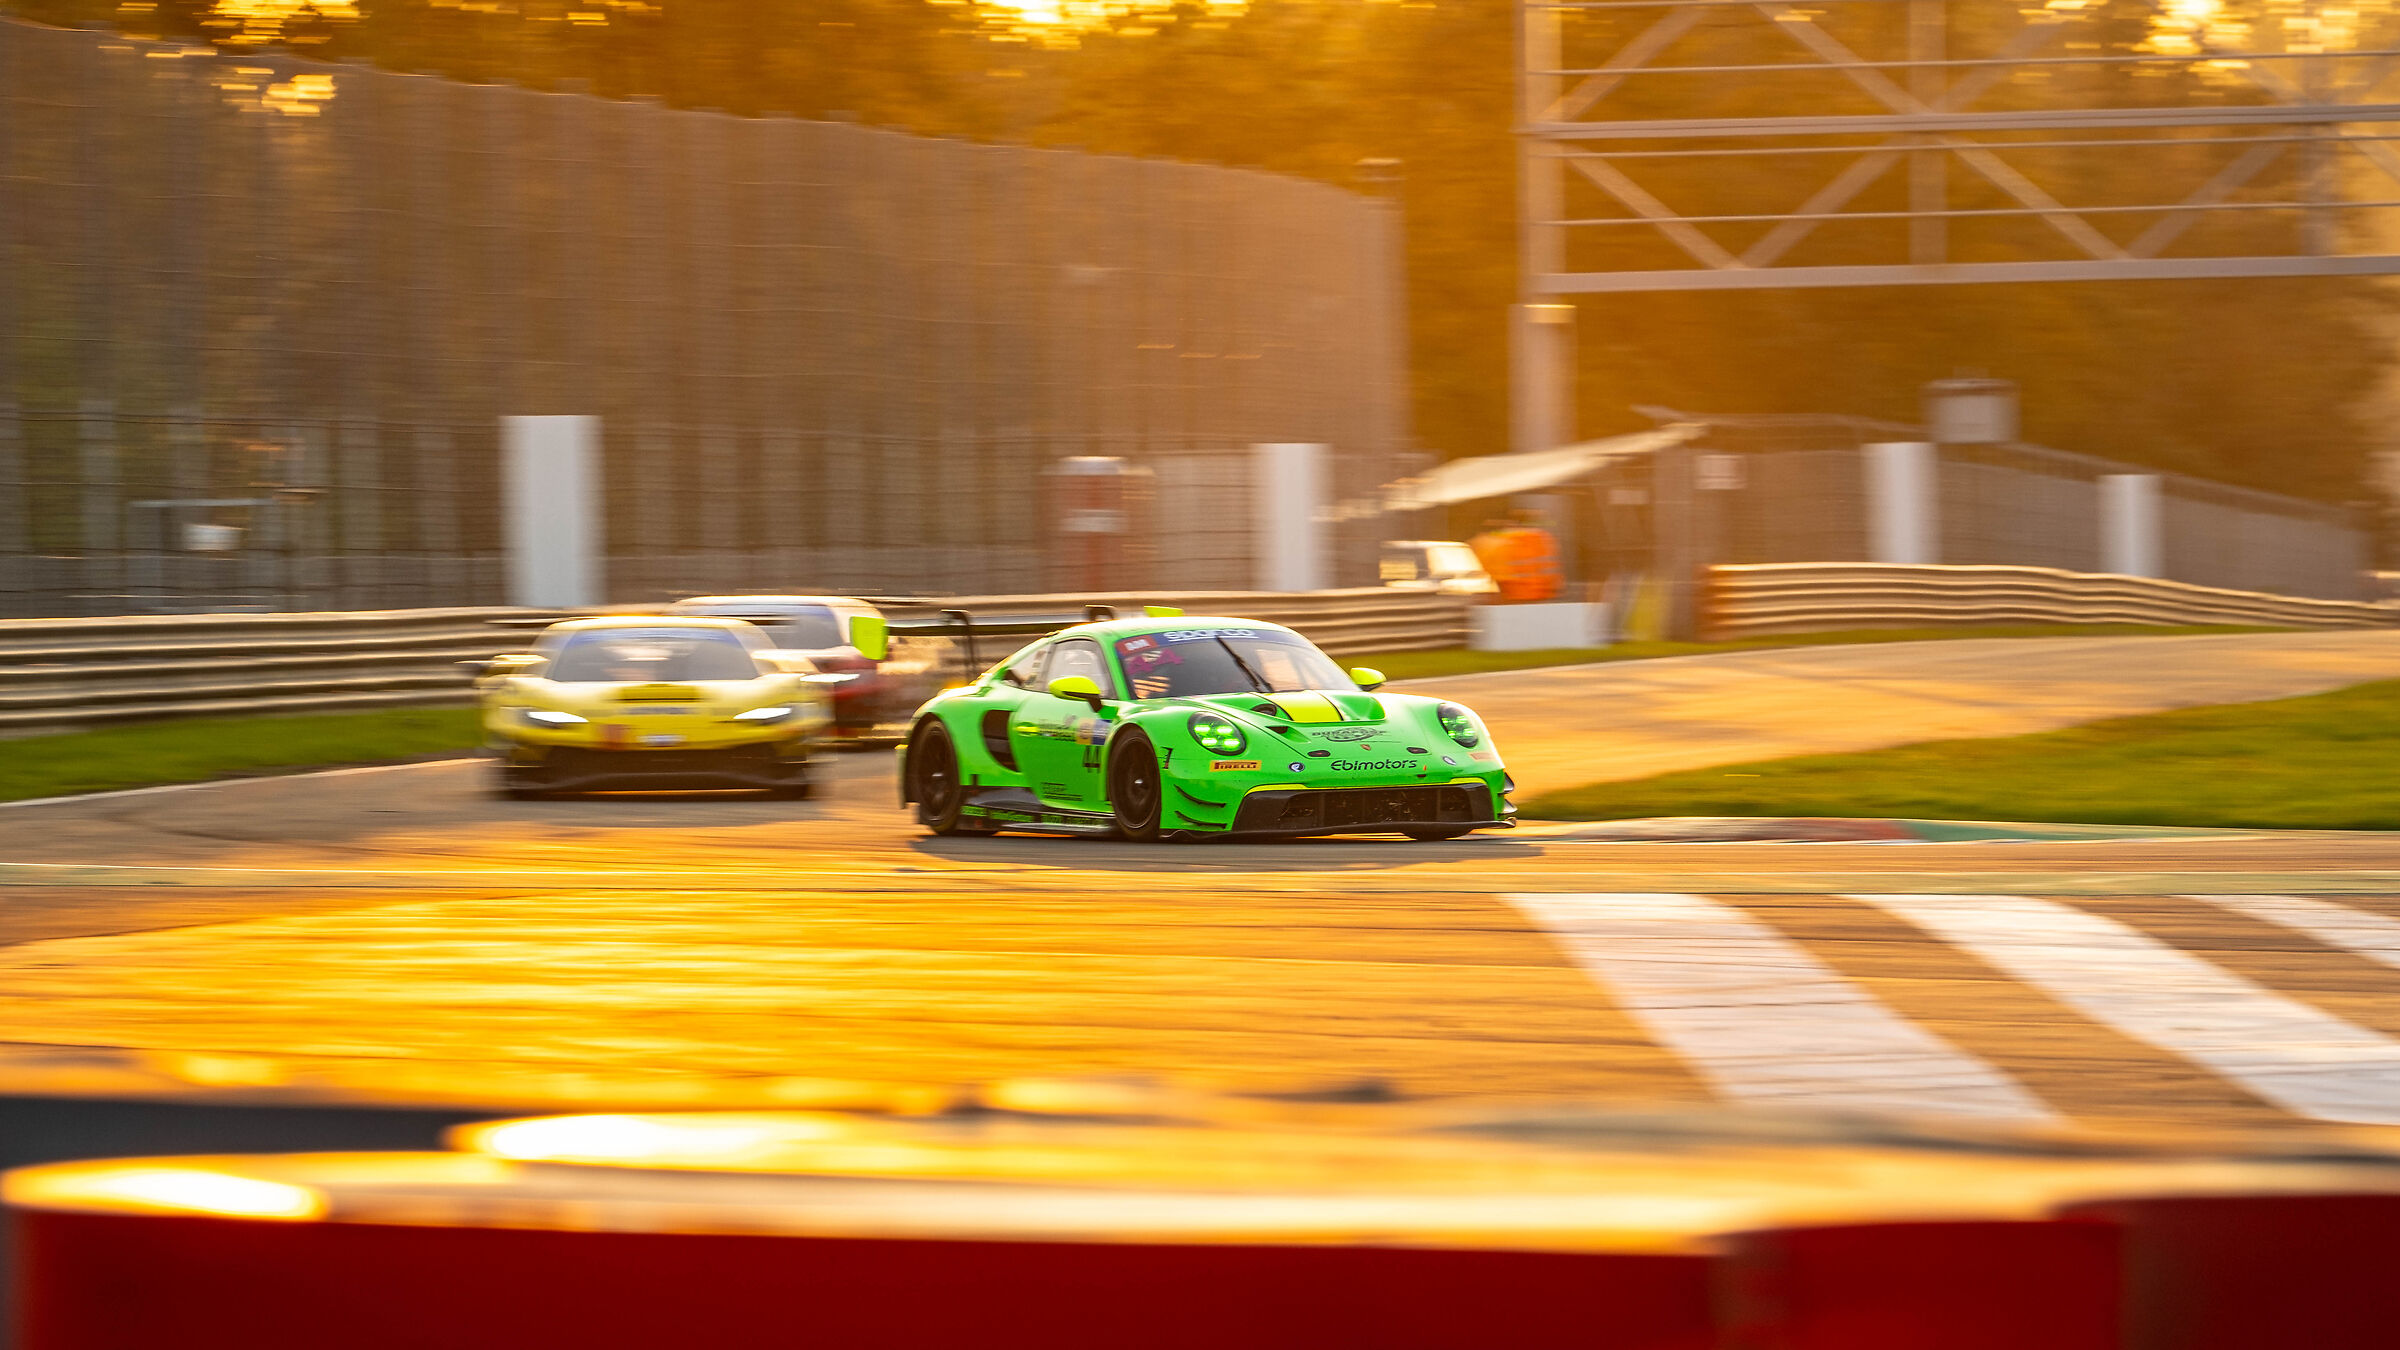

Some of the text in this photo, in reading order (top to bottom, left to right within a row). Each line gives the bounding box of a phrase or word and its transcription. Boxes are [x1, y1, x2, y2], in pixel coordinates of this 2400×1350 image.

[1082, 745, 1101, 773] 44
[1330, 759, 1418, 771] Ebimotors
[1214, 761, 1258, 770] PIRELLI
